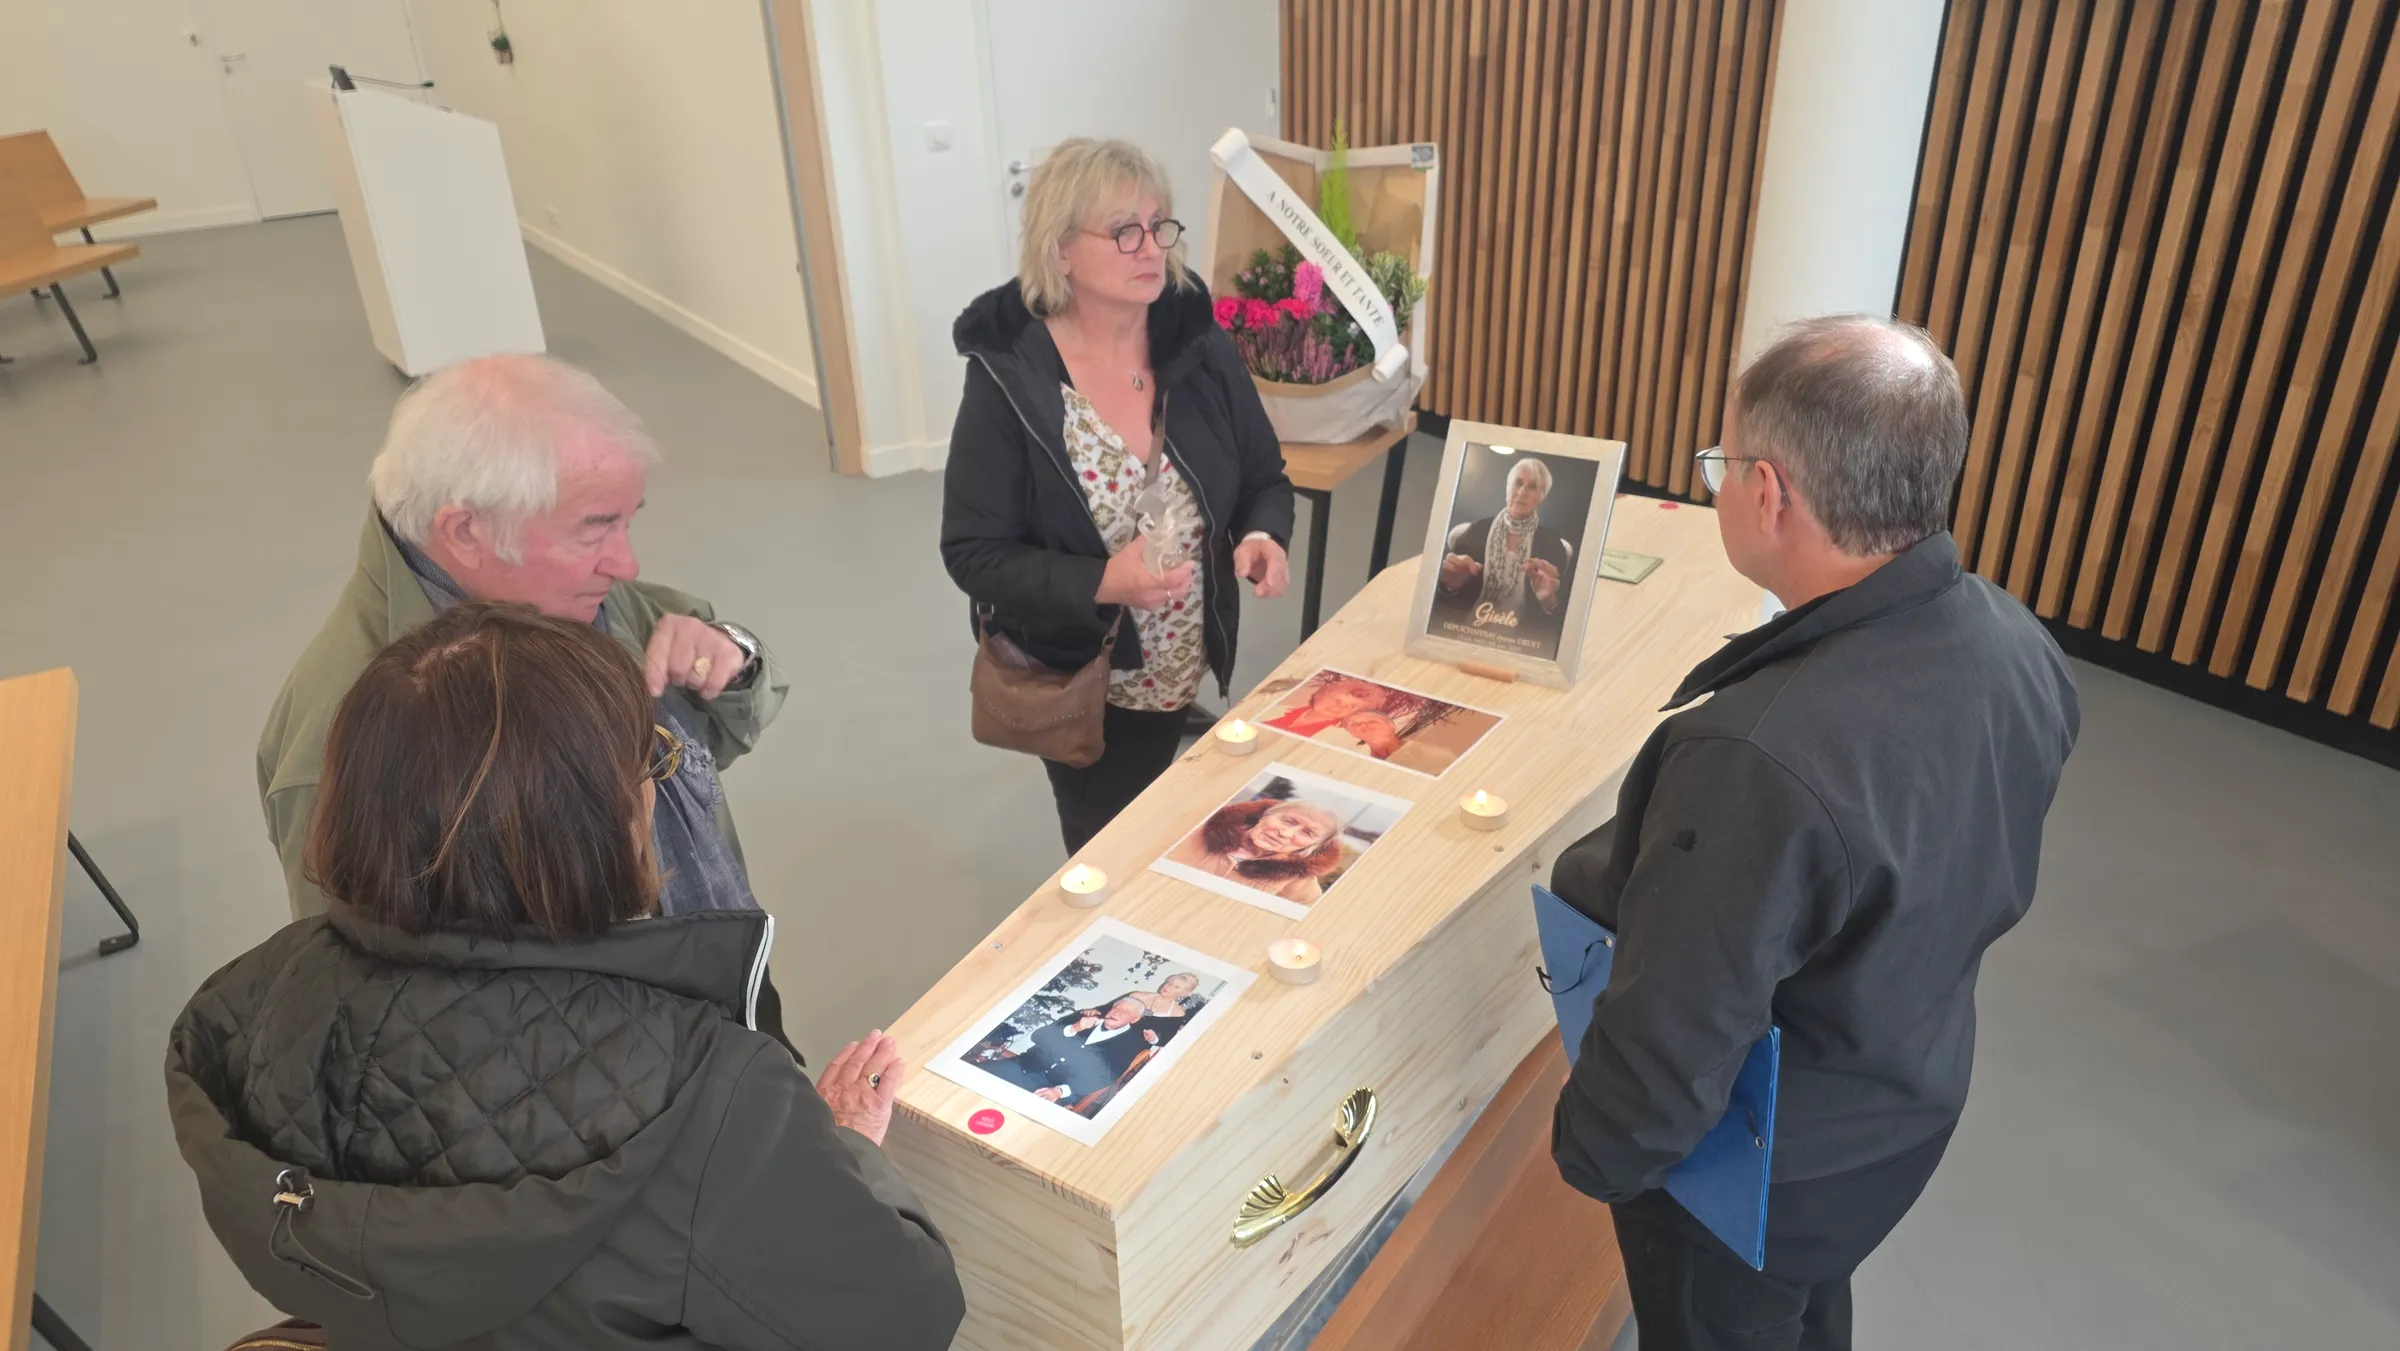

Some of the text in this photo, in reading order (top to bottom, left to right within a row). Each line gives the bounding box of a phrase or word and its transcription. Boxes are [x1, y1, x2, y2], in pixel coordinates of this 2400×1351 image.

[1266, 190, 1385, 326] A NOTRE SOEUR ET TANTE
[1473, 602, 1518, 627] Gisèle
